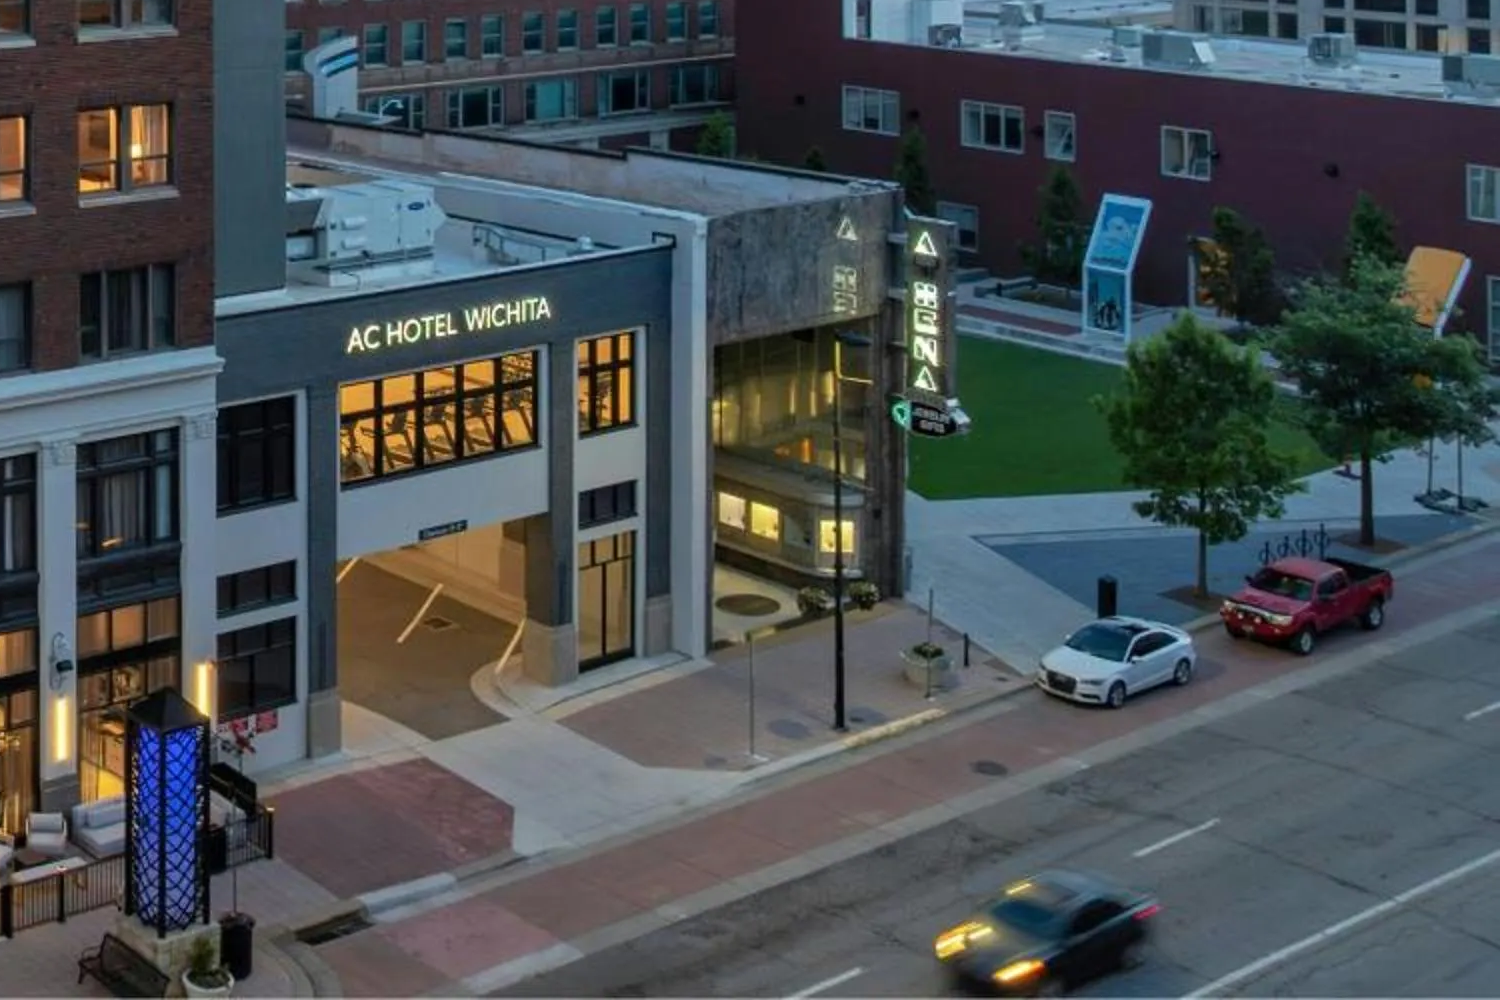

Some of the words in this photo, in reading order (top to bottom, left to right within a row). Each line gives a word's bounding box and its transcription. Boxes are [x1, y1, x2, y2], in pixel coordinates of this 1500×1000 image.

[347, 326, 382, 353] AC
[386, 312, 458, 346] HOTEL
[464, 296, 551, 332] WICHITA
